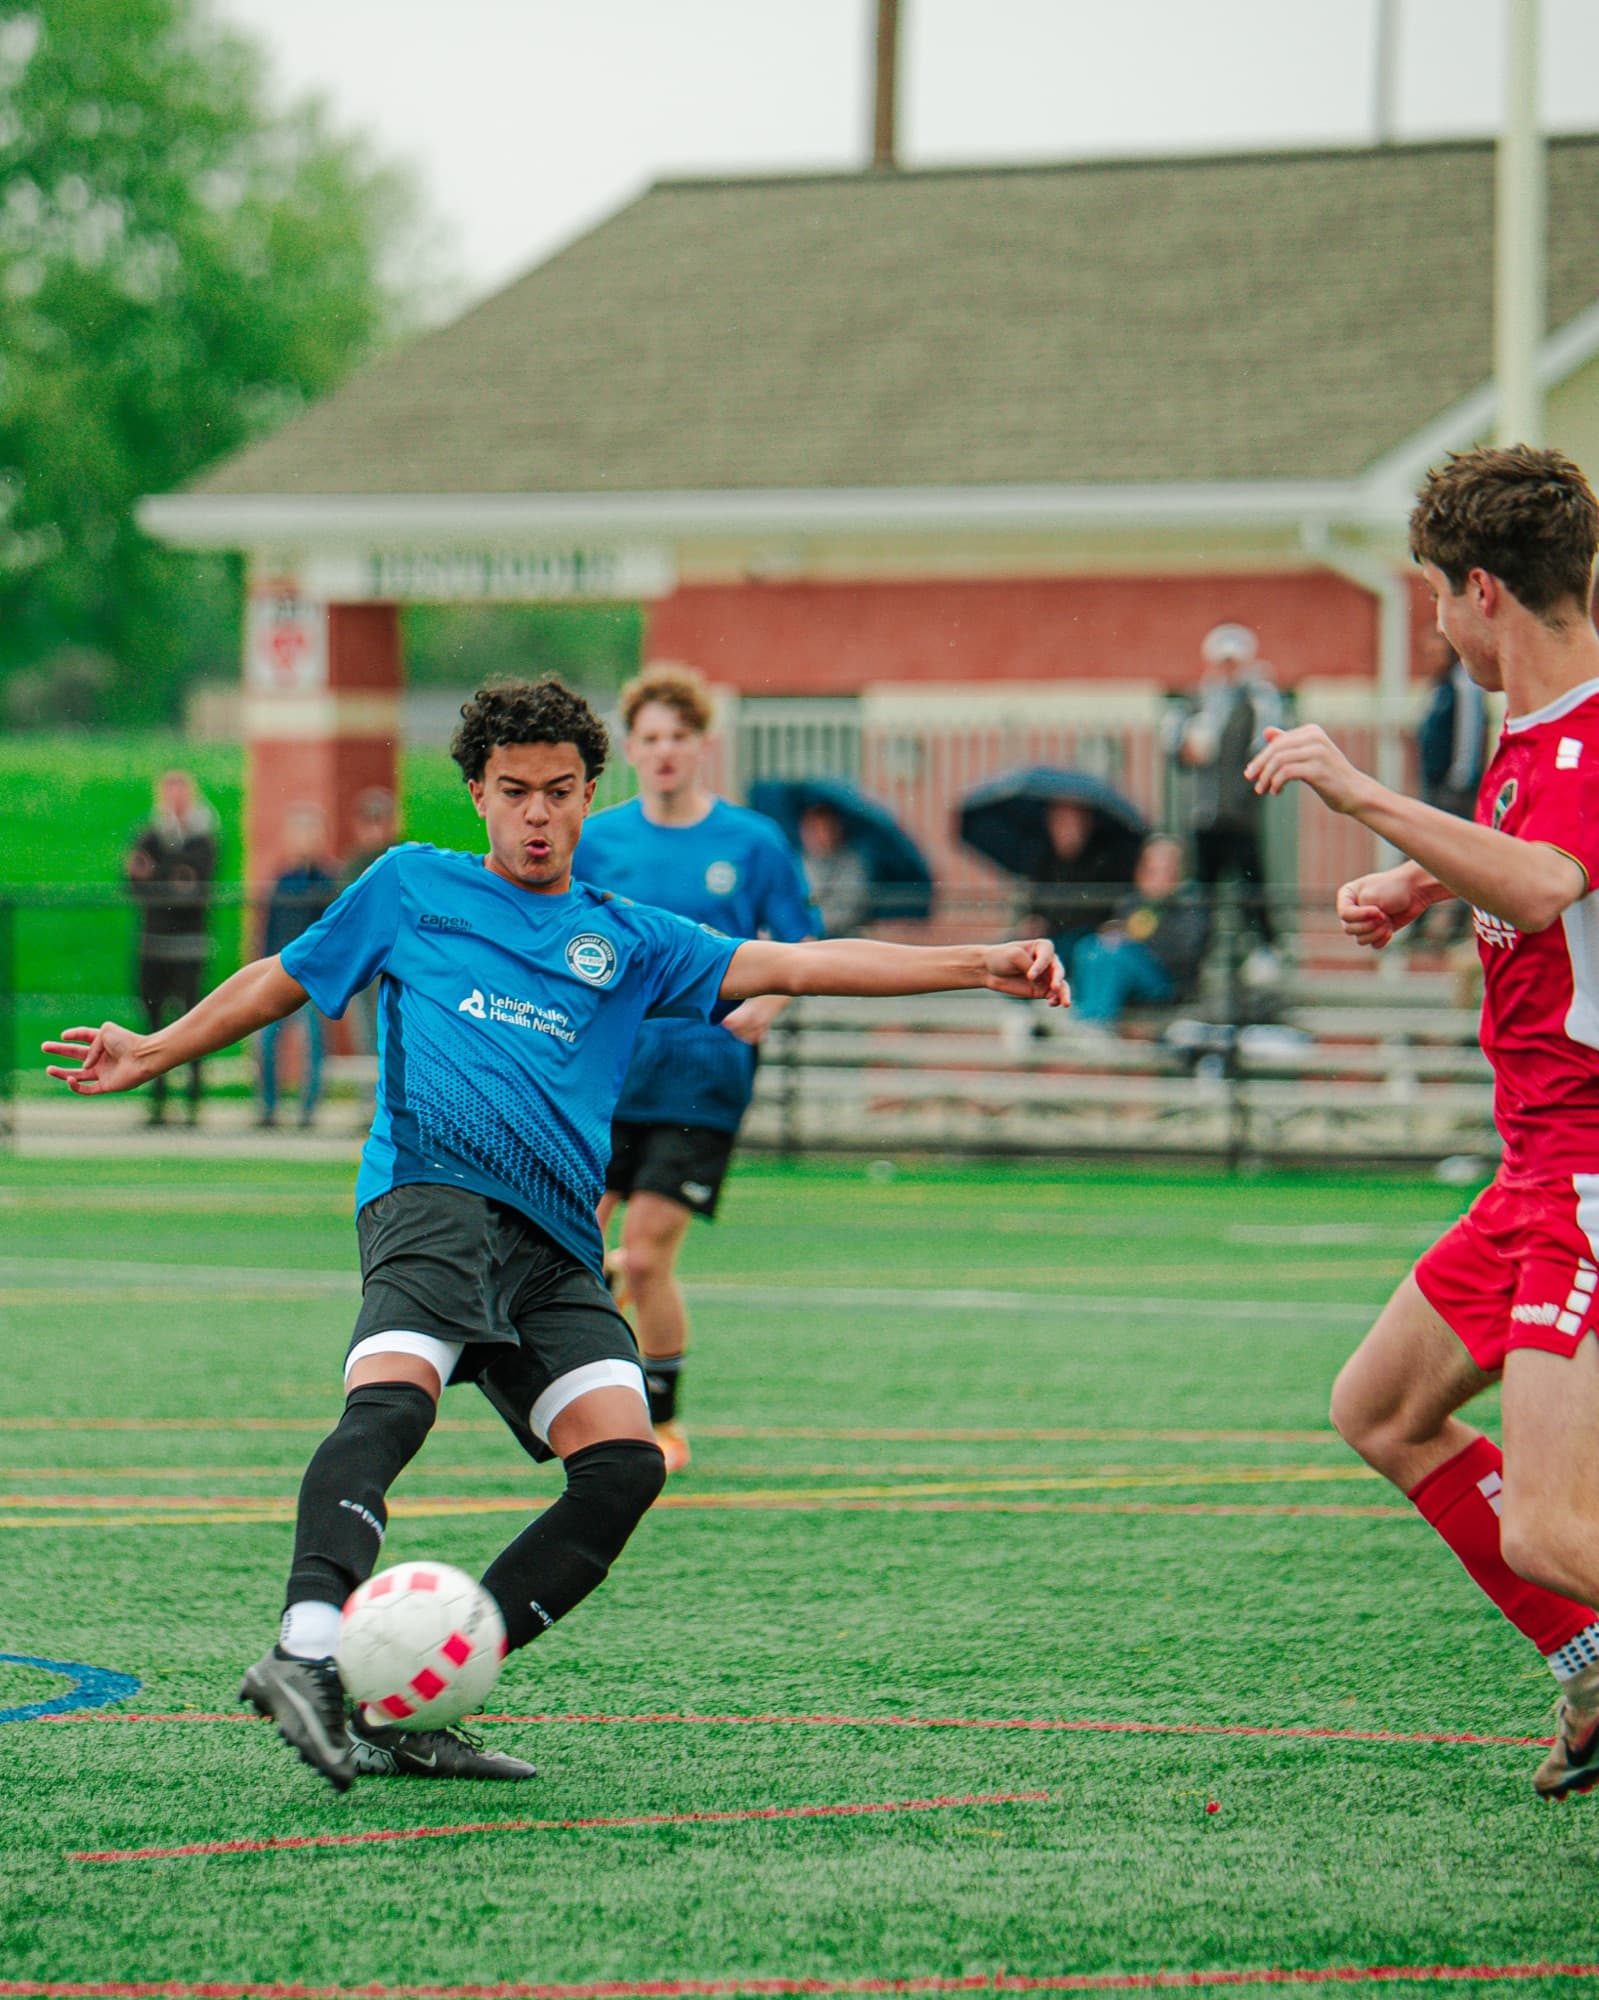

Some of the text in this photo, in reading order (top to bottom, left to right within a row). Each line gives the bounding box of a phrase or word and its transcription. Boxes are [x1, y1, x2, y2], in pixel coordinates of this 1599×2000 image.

[490, 993, 569, 1027] Lehigh Valley
[490, 1007, 577, 1044] Health Network
